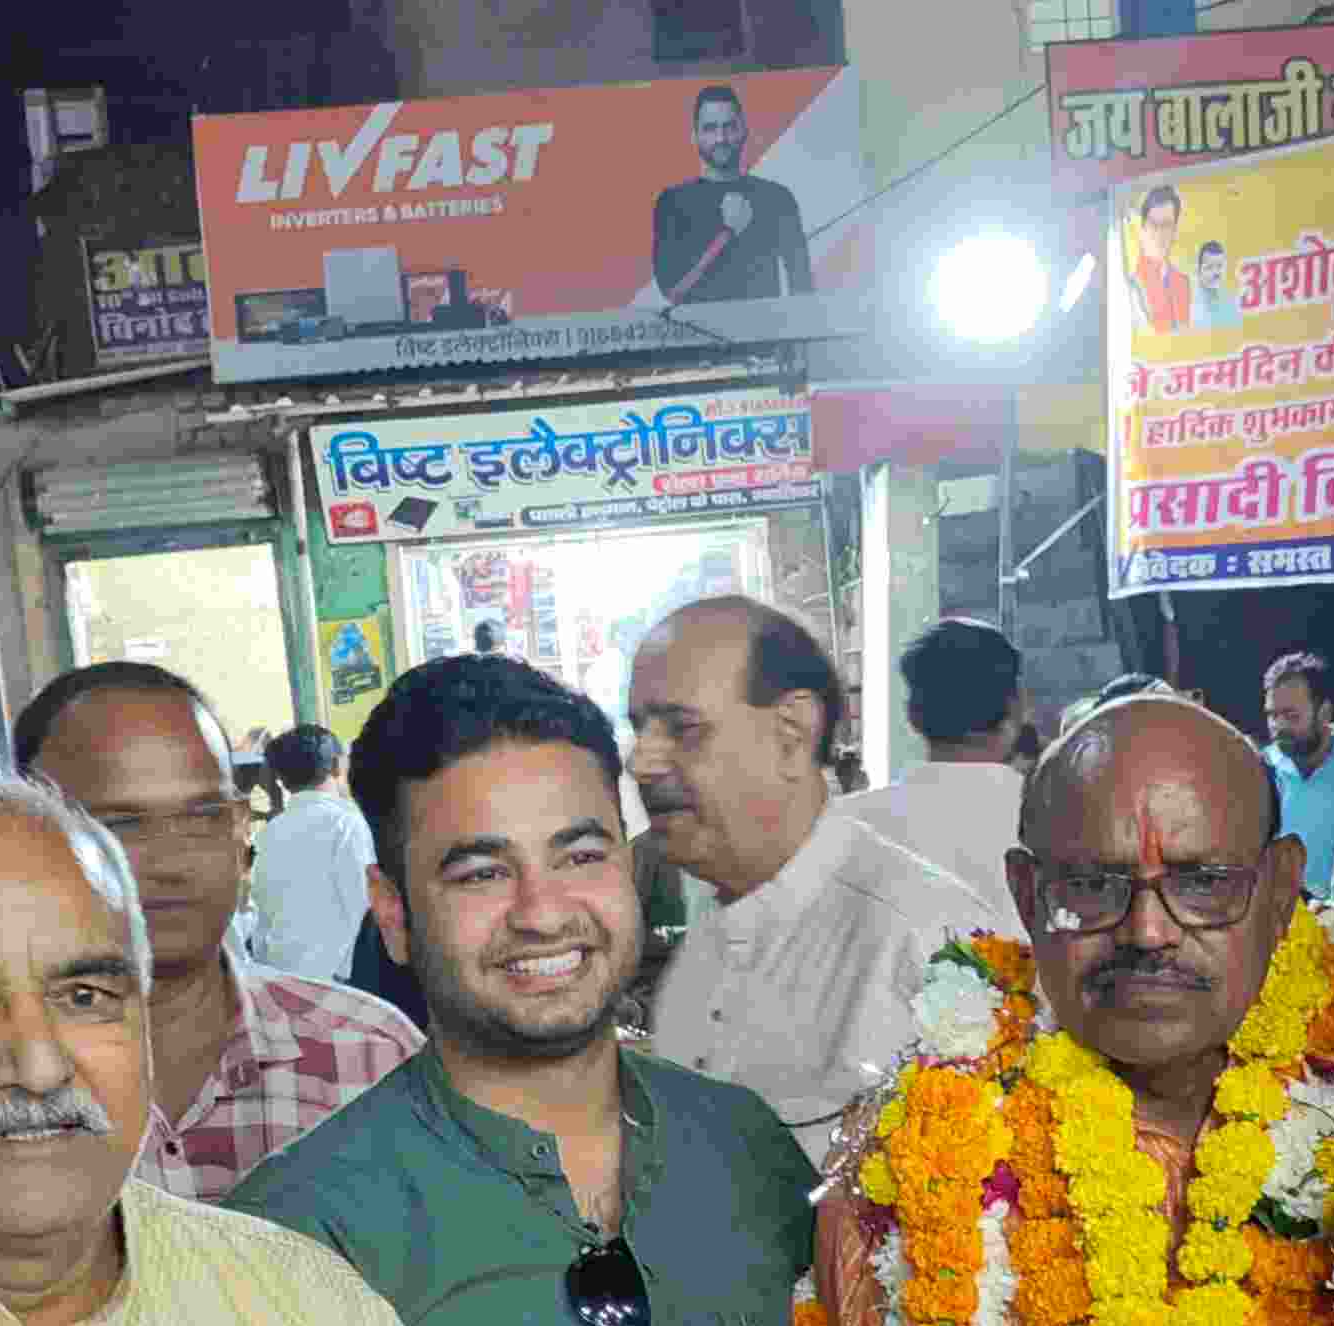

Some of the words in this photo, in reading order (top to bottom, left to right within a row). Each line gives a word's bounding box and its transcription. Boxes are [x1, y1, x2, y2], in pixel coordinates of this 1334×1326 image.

[1065, 90, 1146, 160] जय
[1149, 56, 1324, 152] बालाजी
[234, 101, 555, 204] LIVFAST
[269, 206, 379, 233] INVERTERS
[382, 202, 399, 223] &
[400, 194, 507, 221] BATTERIES
[1163, 344, 1306, 395] जन्मदिन
[1144, 408, 1236, 447] हार्दिक
[1245, 546, 1332, 577] समस्त
